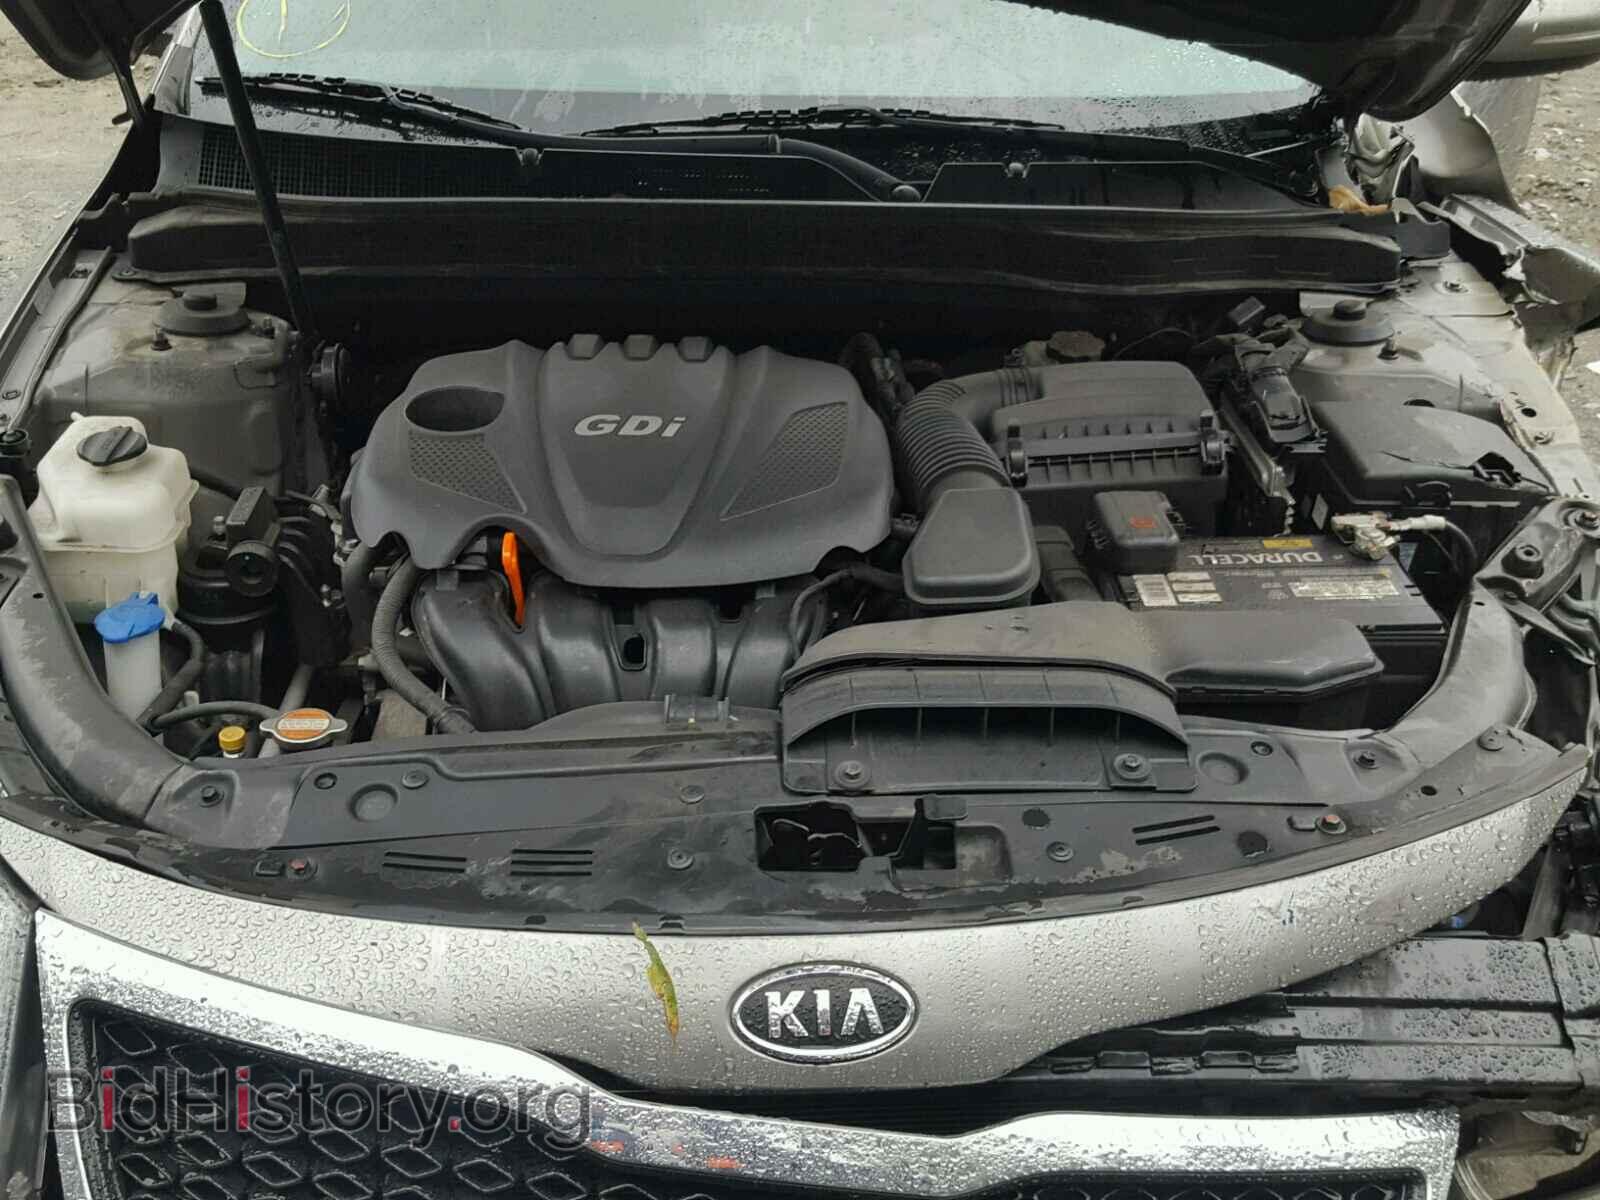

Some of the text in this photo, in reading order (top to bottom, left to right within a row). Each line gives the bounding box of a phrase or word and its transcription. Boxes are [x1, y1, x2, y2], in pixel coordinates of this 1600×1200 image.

[574, 414, 687, 437] GDi
[1189, 551, 1324, 566] DURACELL
[764, 987, 885, 1039] KIA
